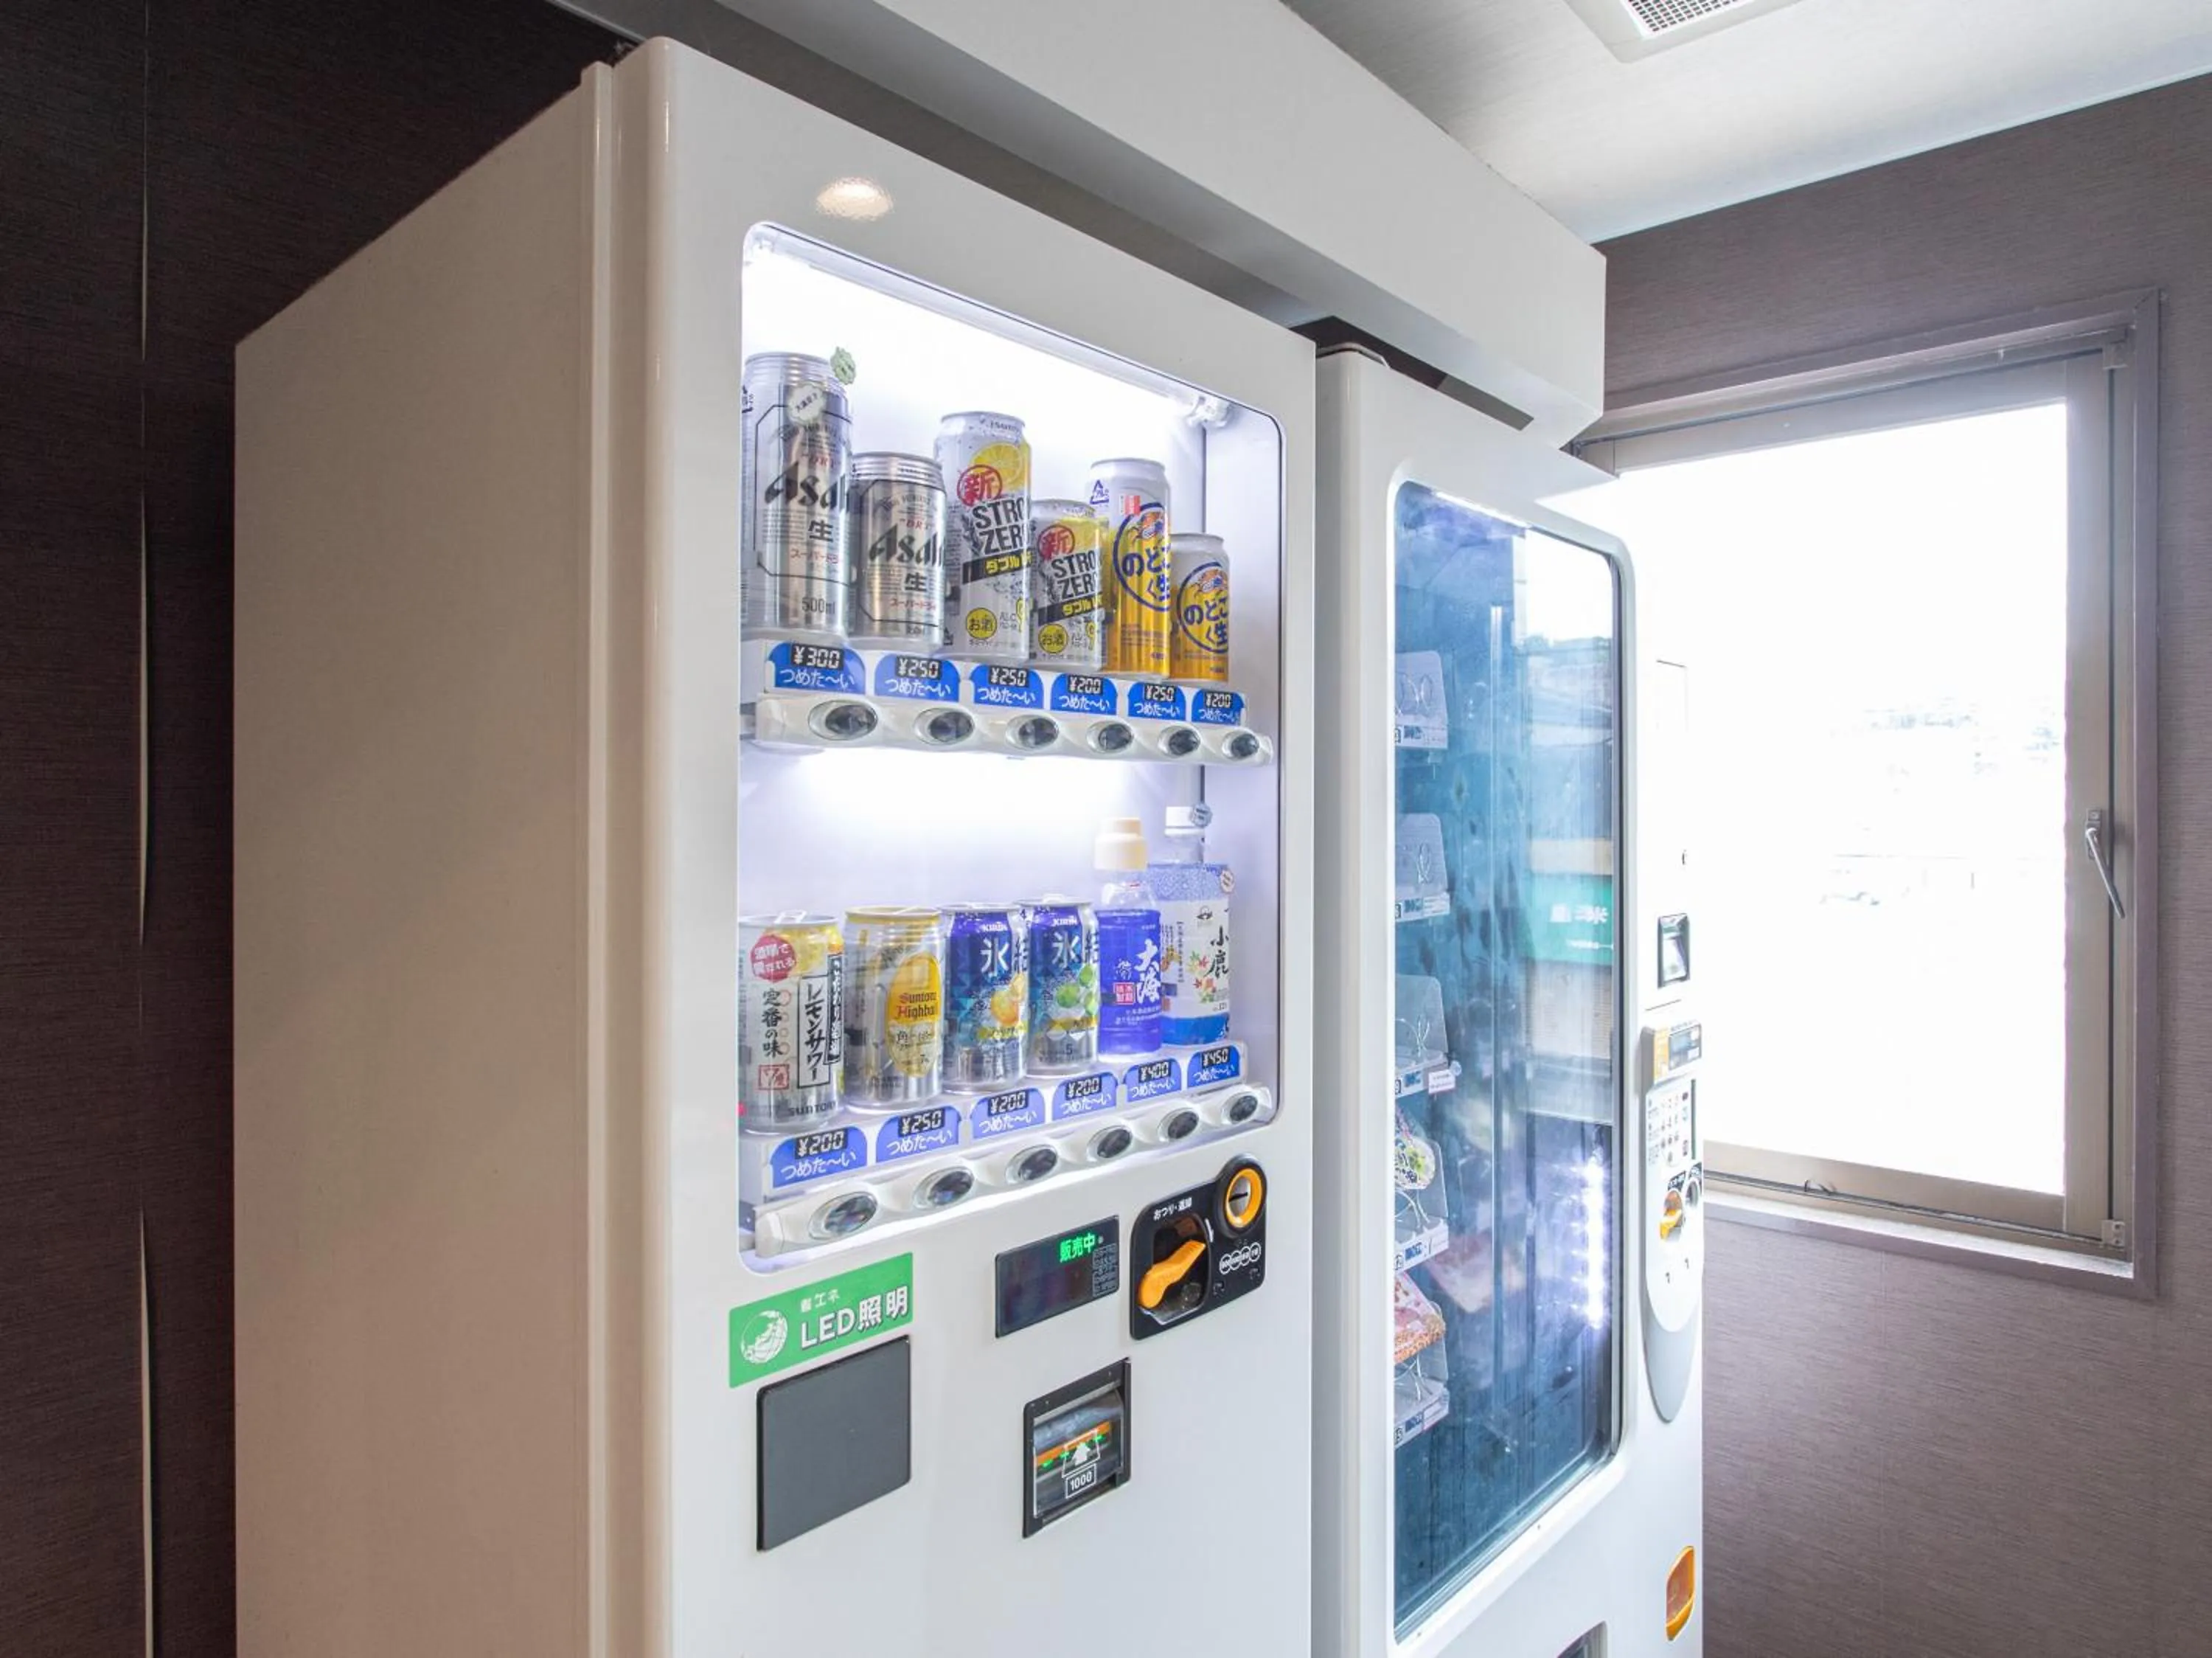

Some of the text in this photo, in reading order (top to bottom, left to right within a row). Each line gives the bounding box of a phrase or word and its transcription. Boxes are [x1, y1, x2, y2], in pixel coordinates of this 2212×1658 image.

[808, 519, 834, 542] 生
[905, 572, 928, 592] 生
[793, 646, 841, 669] ¥300
[898, 657, 939, 679] ¥250
[990, 667, 1026, 687] ¥250
[1069, 676, 1101, 694] ¥200
[1146, 684, 1174, 701] ¥250
[1206, 692, 1232, 708] ¥200
[761, 988, 783, 1058] 定番の味
[804, 982, 825, 1081] レモンサワー
[1203, 1048, 1228, 1066] ¥450
[1141, 1061, 1169, 1081] ¥400
[1068, 1077, 1099, 1097] ¥200
[990, 1092, 1026, 1114] ¥200
[901, 1110, 942, 1135] ¥250
[798, 1131, 844, 1156] ¥200
[1059, 1232, 1095, 1263] 販売中
[801, 1286, 908, 1349] LED照明
[1070, 1471, 1092, 1491] 1000
